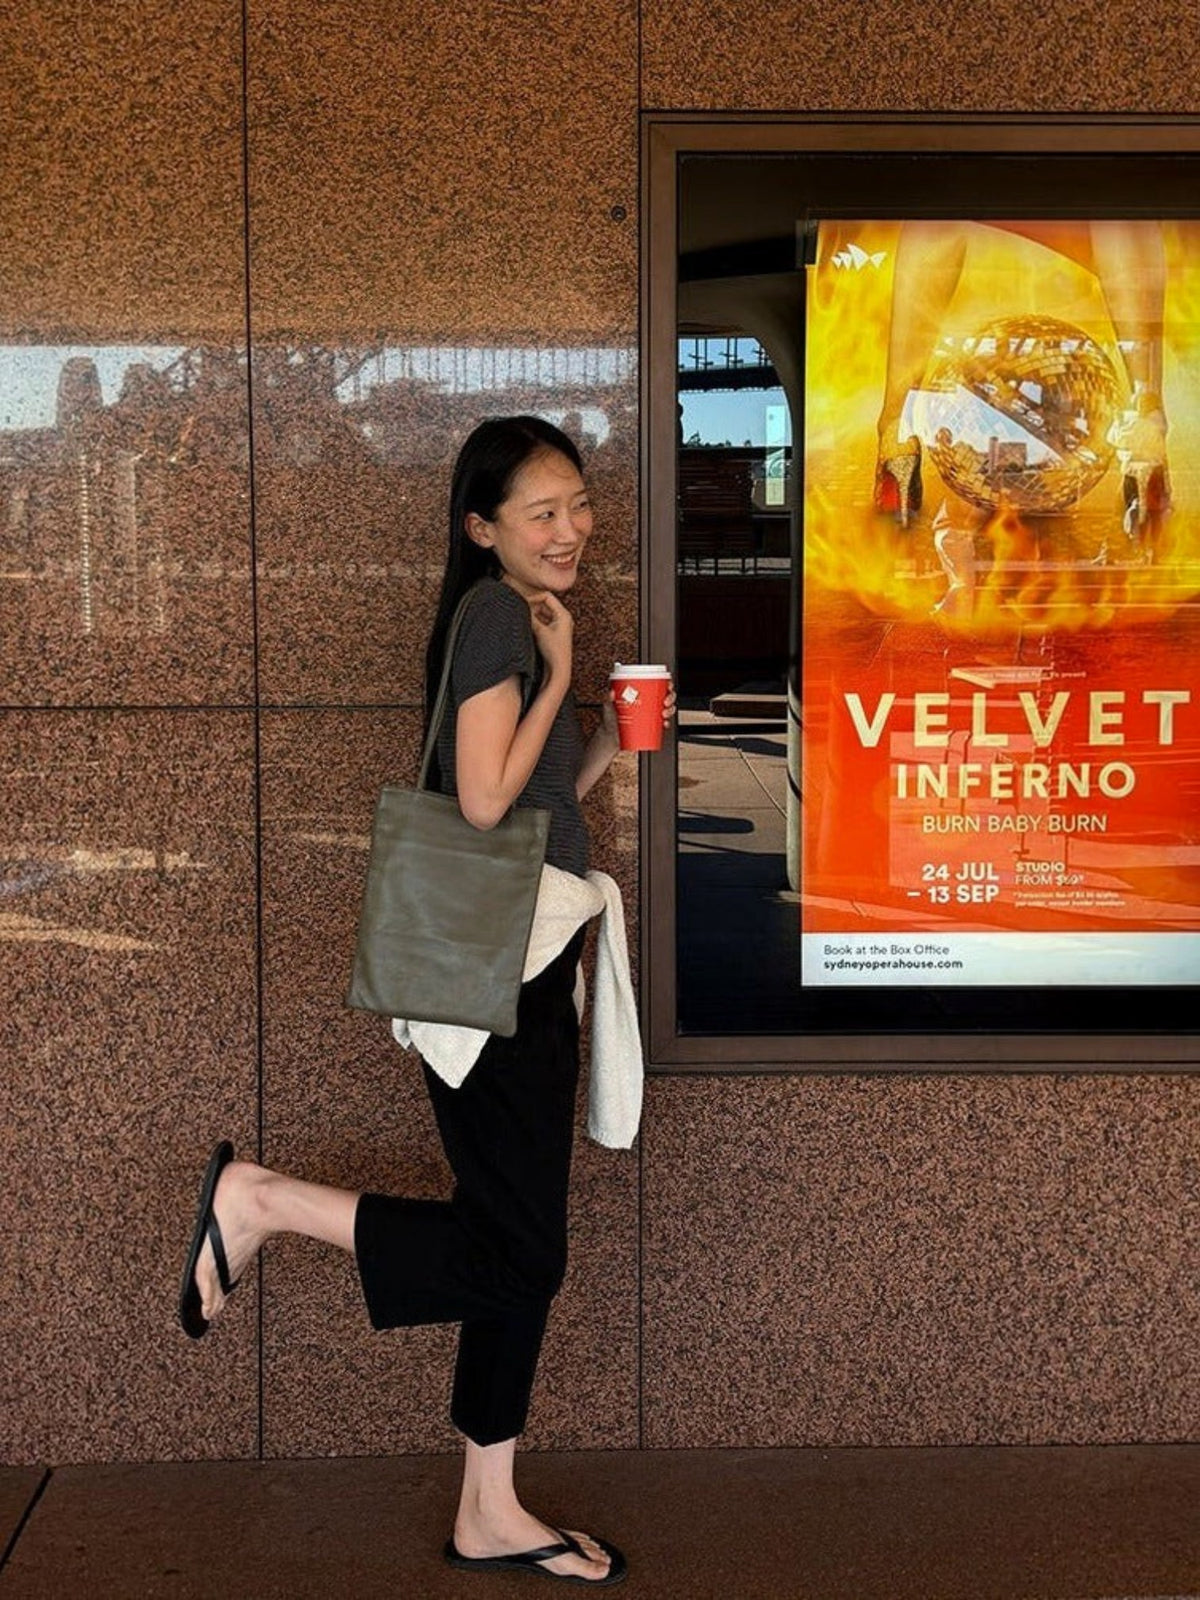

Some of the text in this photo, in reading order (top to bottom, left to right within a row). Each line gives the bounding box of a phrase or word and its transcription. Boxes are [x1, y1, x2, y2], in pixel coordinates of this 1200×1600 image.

[844, 690, 1191, 748] VELVET
[896, 761, 1136, 799] INFERNO
[922, 814, 1107, 834] BURN BABY BURN
[921, 862, 1000, 882] 24 JUL
[1015, 861, 1065, 873] STUDIO
[1015, 874, 1053, 886] FROM
[927, 885, 952, 904] 13
[956, 885, 1000, 904] SEP
[823, 944, 950, 956] Book at the Box Office
[823, 958, 963, 972] sydneyoperahouse.com
